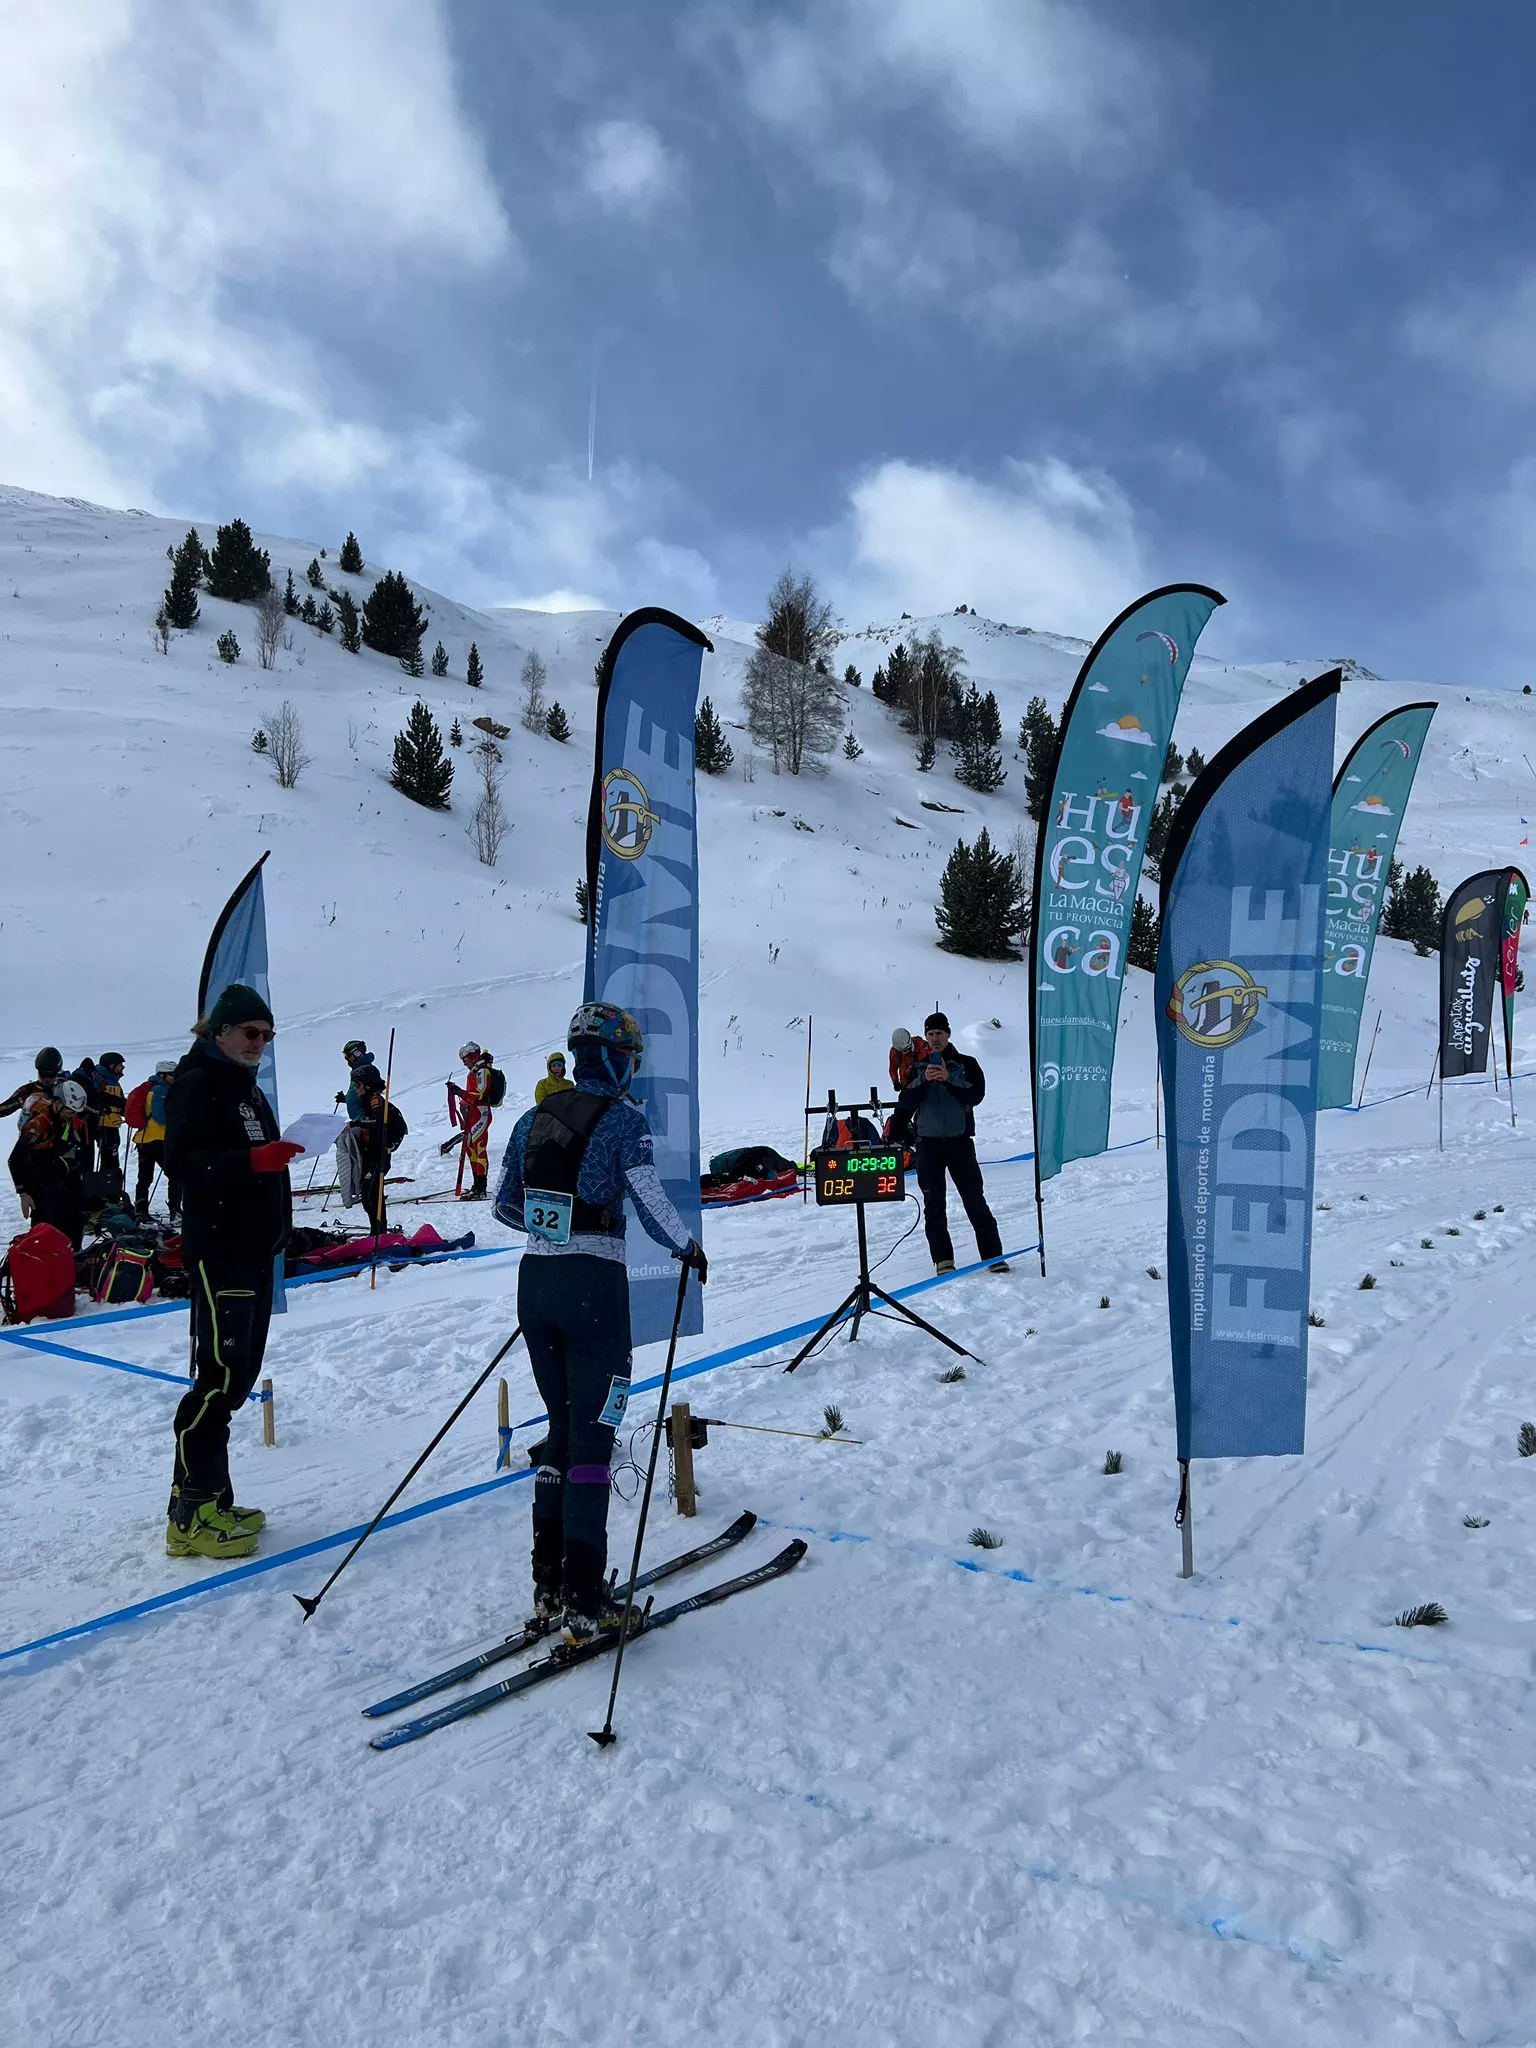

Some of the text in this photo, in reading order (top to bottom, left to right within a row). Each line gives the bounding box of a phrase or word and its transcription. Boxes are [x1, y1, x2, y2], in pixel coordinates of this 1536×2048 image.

[1211, 884, 1320, 1349] FEDME
[847, 1157, 896, 1172] 10:29:28
[824, 1179, 854, 1196] 032
[877, 1176, 897, 1193] 32
[1190, 1055, 1216, 1331] impulsando los deportes de montaña
[531, 1207, 560, 1230] 32
[1215, 1328, 1296, 1344] www.fedme.es
[740, 1566, 779, 1583] TRAB
